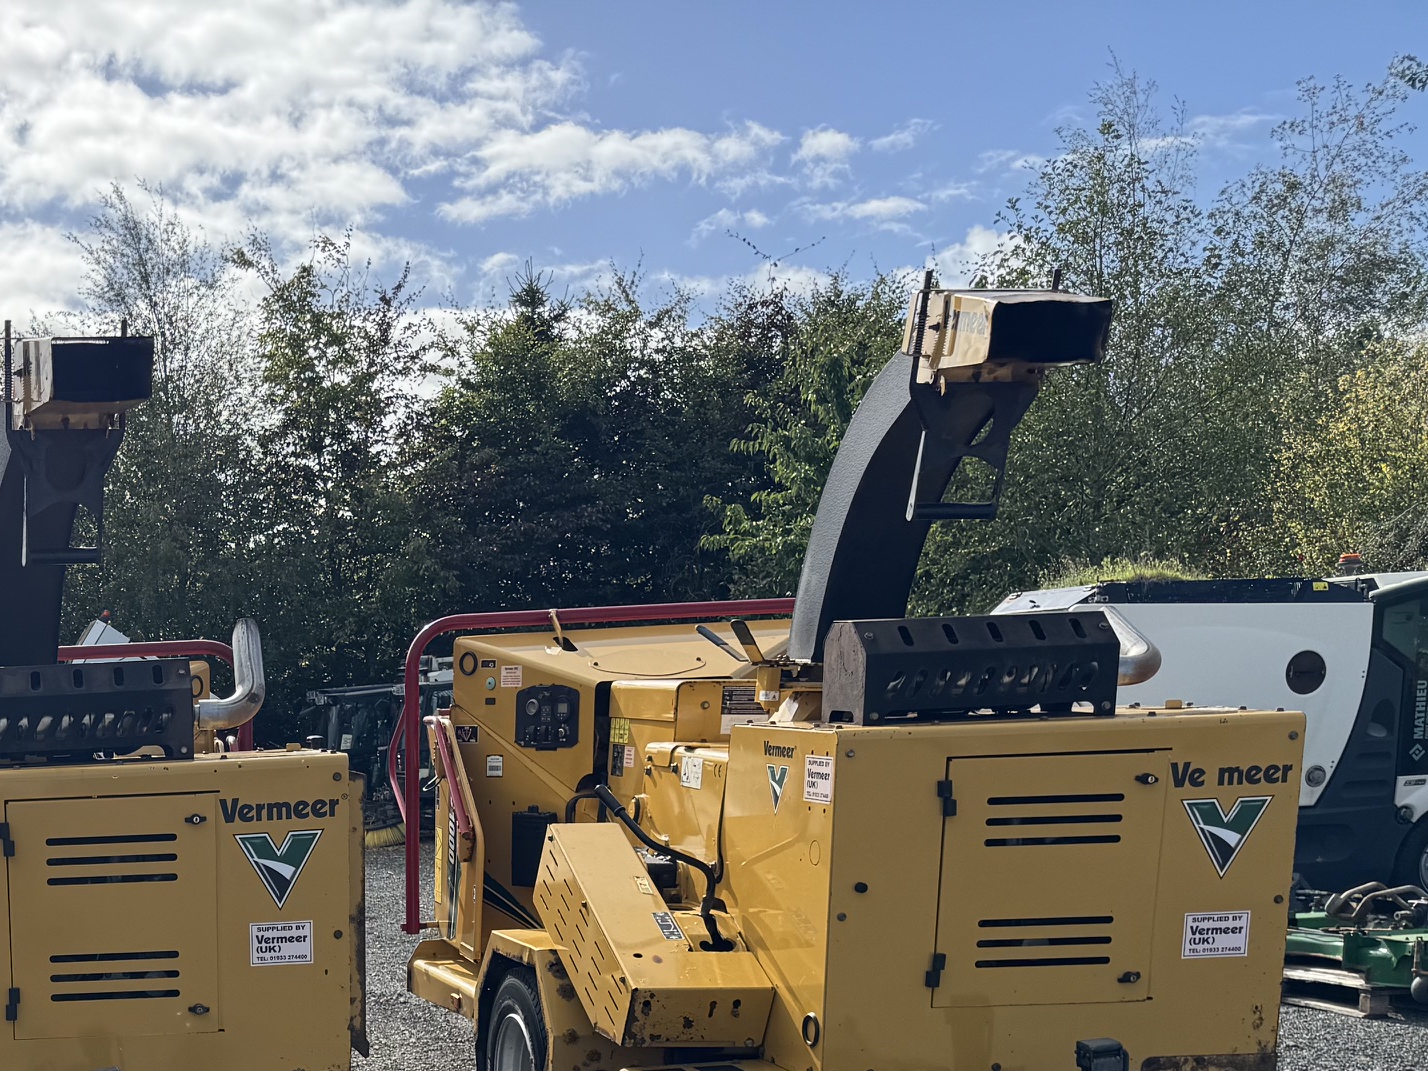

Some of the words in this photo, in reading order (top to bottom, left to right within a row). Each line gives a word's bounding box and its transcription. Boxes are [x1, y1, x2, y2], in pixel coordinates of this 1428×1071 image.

[1413, 680, 1428, 740] MATHIEU
[763, 740, 795, 759] Vermeer
[807, 768, 831, 781] Vermeer
[218, 798, 340, 824] Vermeer
[1192, 915, 1230, 923] SUPPLIED
[1189, 925, 1244, 936] Vermeer
[255, 934, 308, 945] Vermeer
[1189, 936, 1216, 946] (UK)
[256, 945, 282, 955] (UK)
